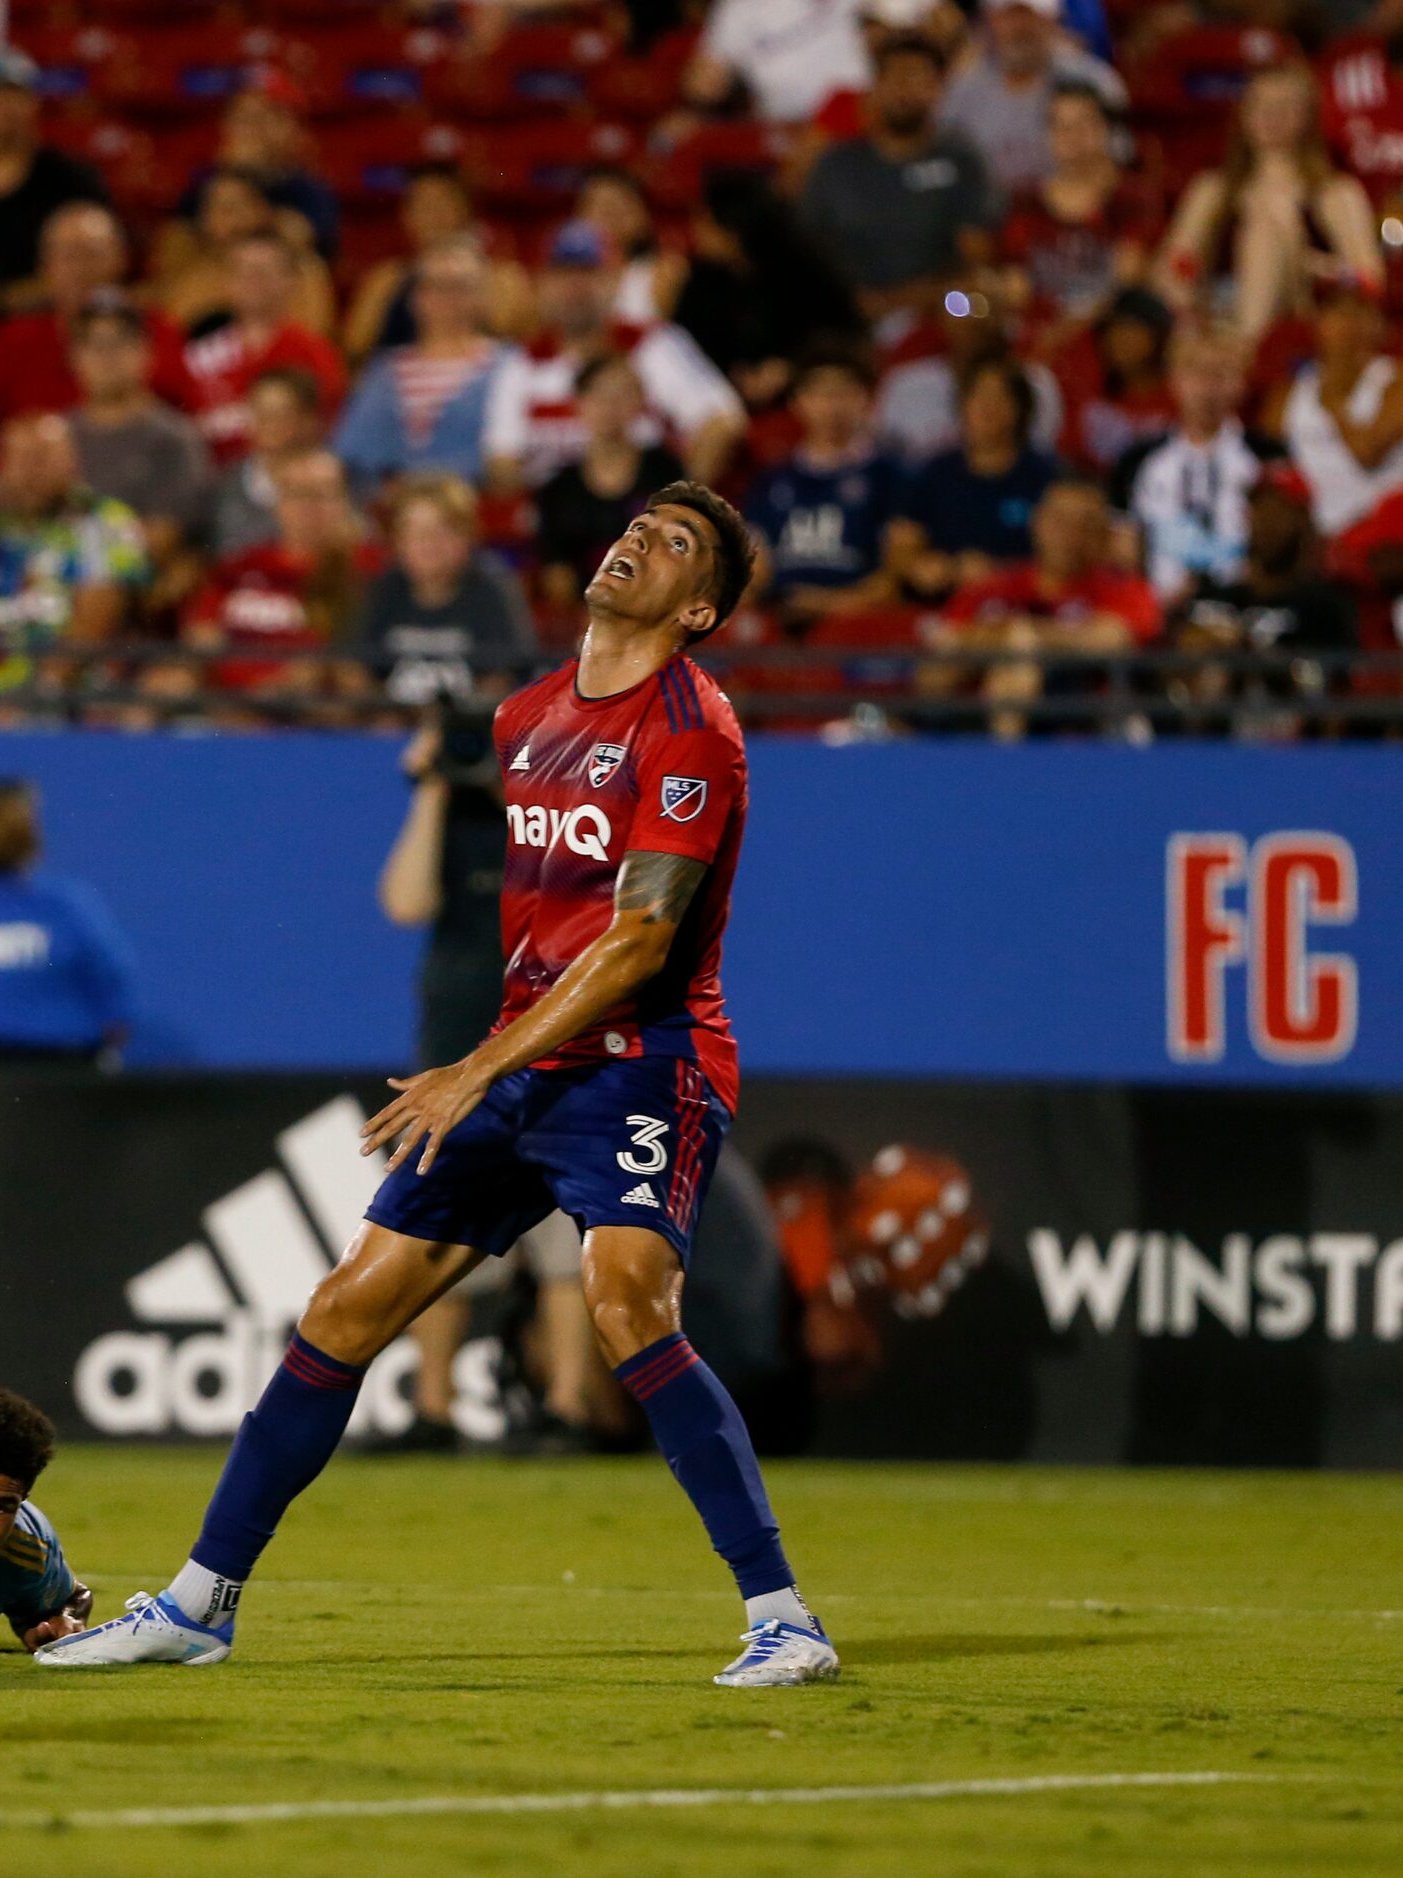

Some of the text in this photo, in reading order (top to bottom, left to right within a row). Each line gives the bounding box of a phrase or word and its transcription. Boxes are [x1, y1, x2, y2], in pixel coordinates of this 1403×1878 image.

[667, 780, 691, 791] MLS
[1165, 829, 1359, 1067] FC
[616, 1114, 670, 1176] 3
